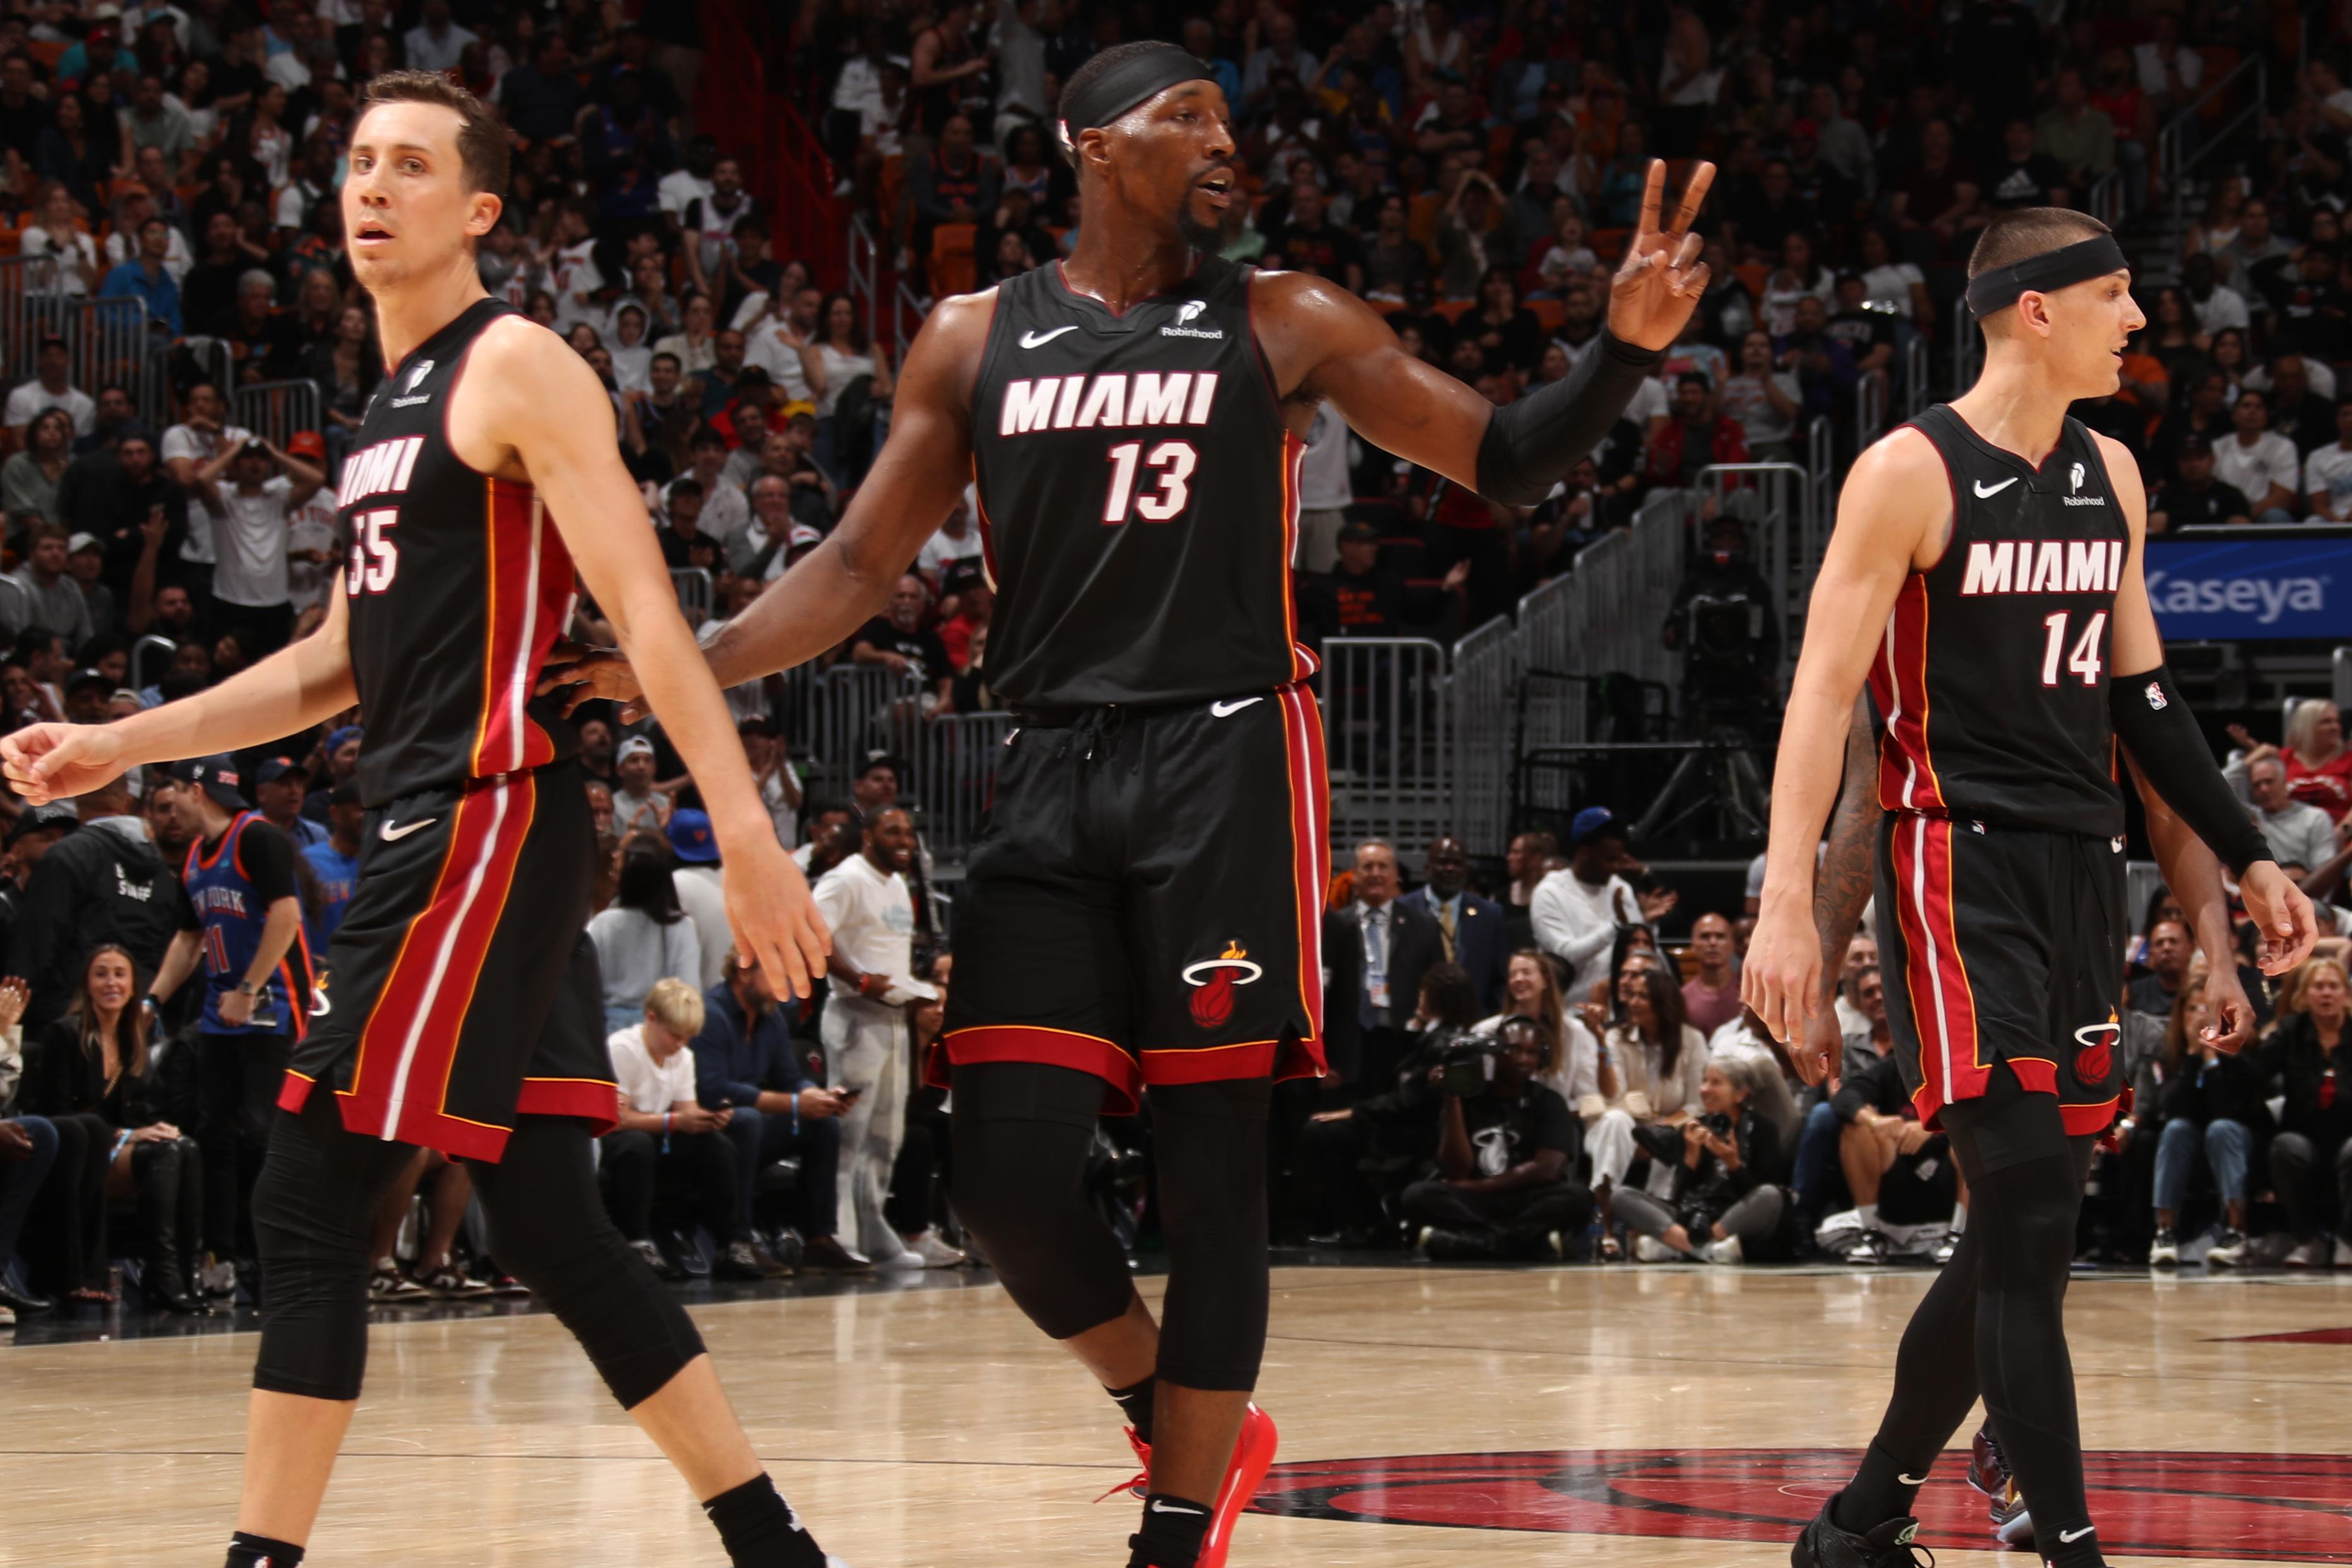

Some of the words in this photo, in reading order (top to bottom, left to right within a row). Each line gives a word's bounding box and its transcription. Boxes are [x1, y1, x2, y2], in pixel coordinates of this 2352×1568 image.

[1161, 326, 1223, 340] Robinhood
[999, 371, 1221, 438] MIAMI
[1101, 438, 1200, 525] 13
[2062, 495, 2105, 507] Robinhood
[1959, 538, 2125, 597] MIAMI
[2041, 609, 2110, 688] 14
